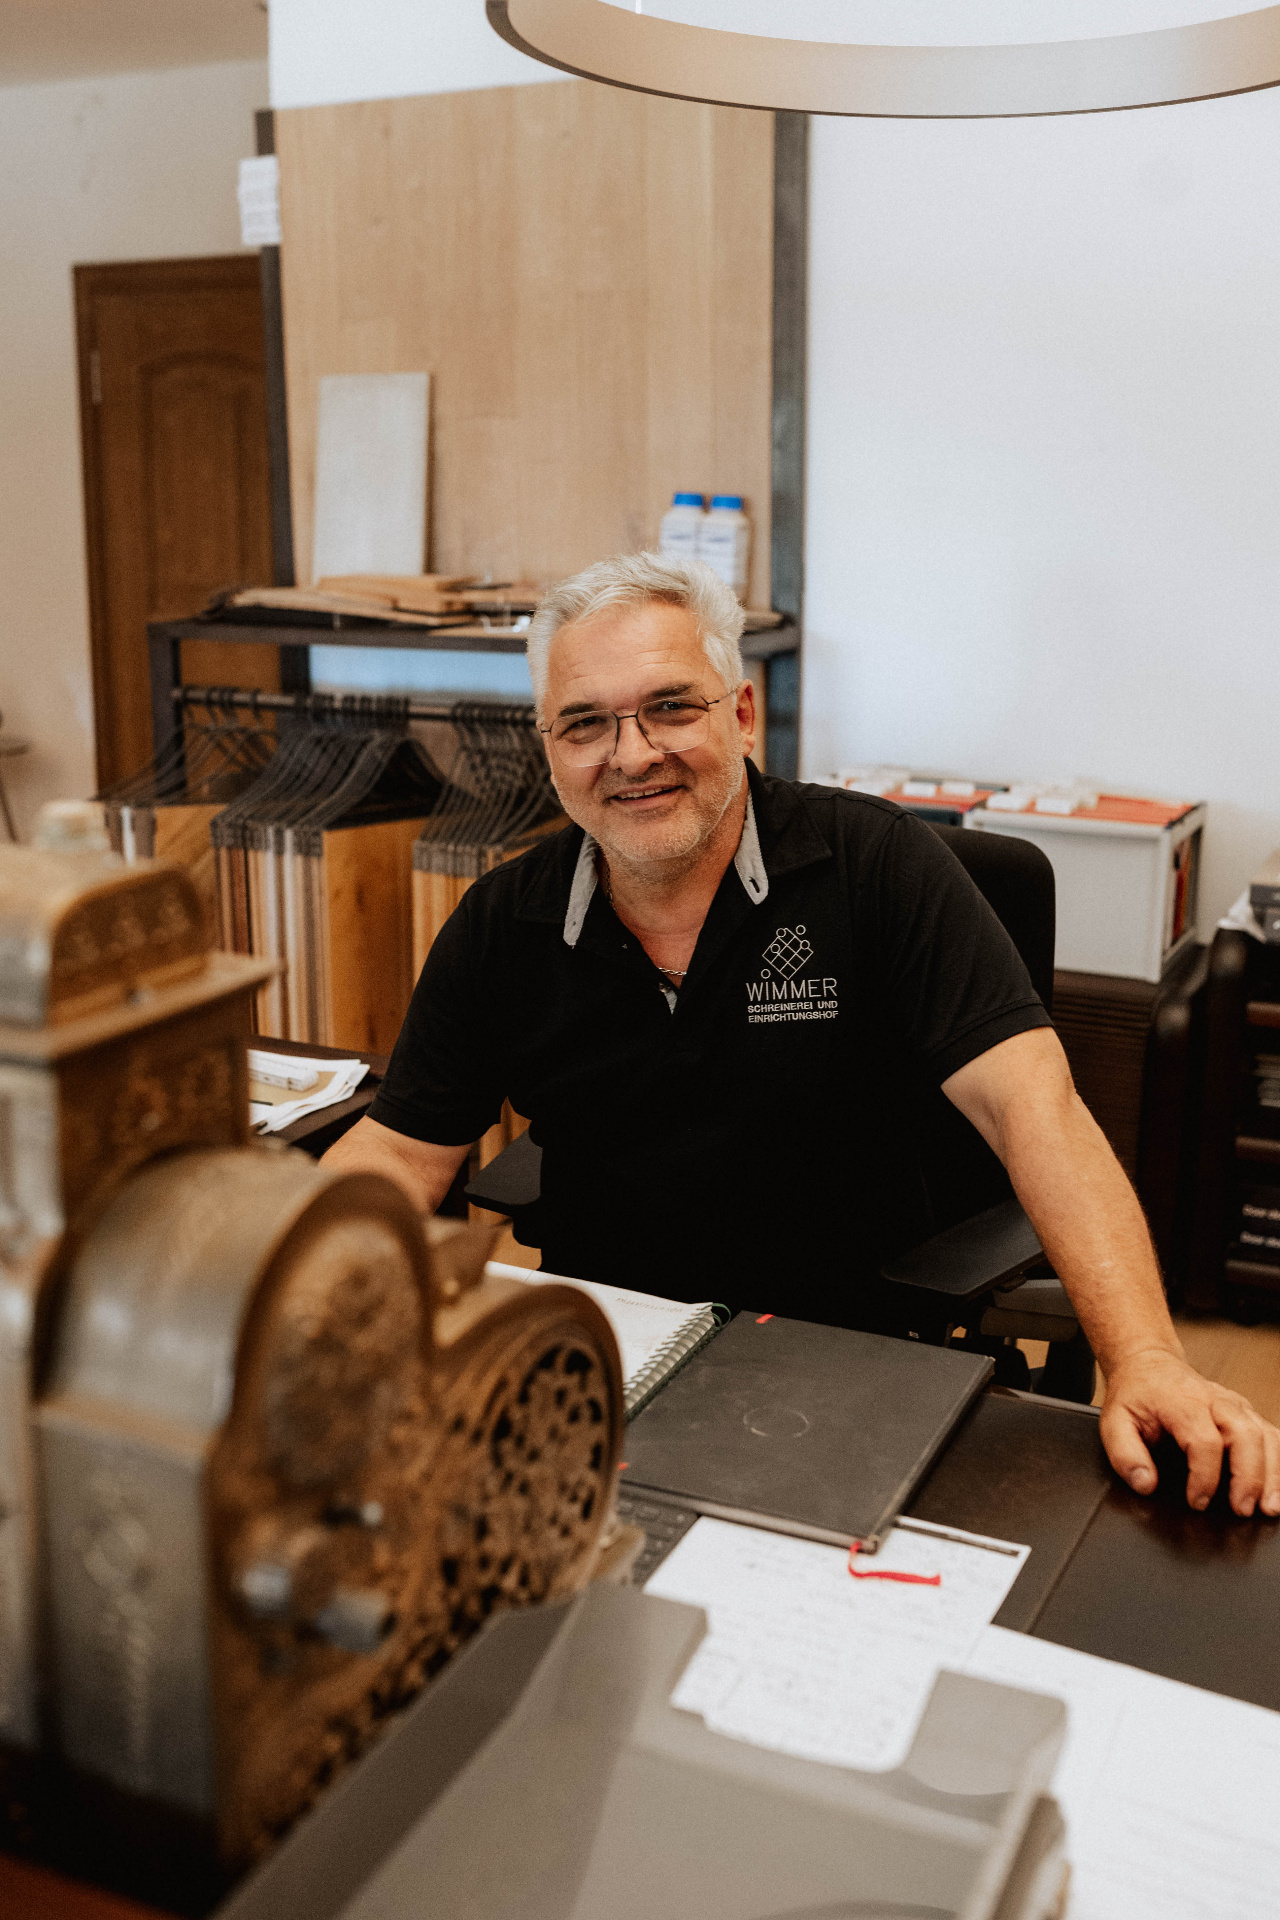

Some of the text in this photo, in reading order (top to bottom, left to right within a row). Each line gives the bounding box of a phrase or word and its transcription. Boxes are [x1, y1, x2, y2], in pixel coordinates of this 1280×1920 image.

[745, 978, 838, 1001] WIMMER
[747, 1000, 838, 1013] SCHREINEREI UND
[748, 1010, 839, 1023] EINRICHTUNGSHOF
